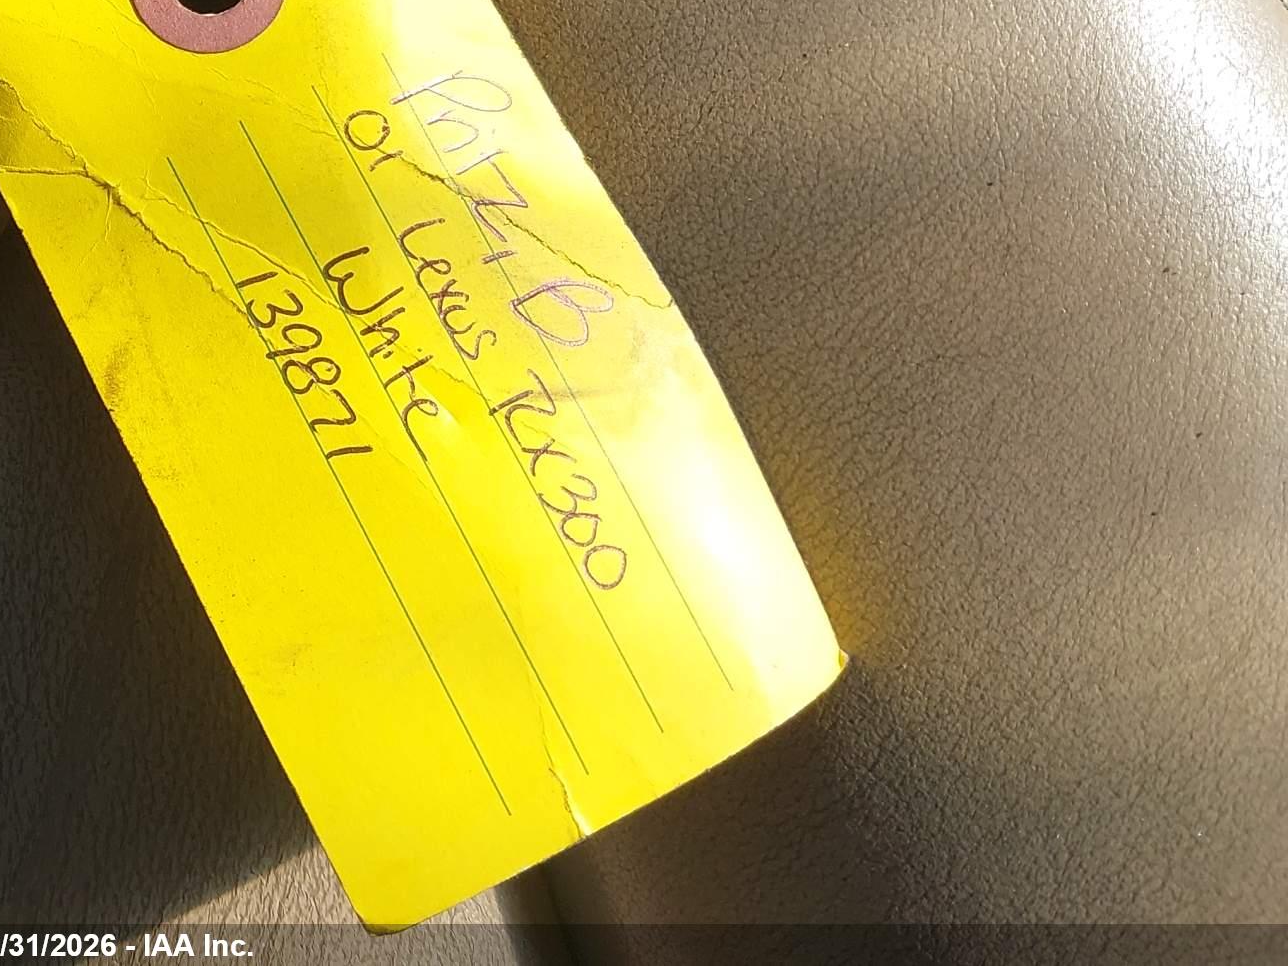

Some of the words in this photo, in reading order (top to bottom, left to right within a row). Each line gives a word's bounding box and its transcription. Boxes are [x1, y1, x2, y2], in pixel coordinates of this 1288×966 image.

[234, 270, 374, 460] 139871
[322, 245, 440, 462] White
[397, 217, 497, 361] Lexus
[509, 278, 614, 347] B
